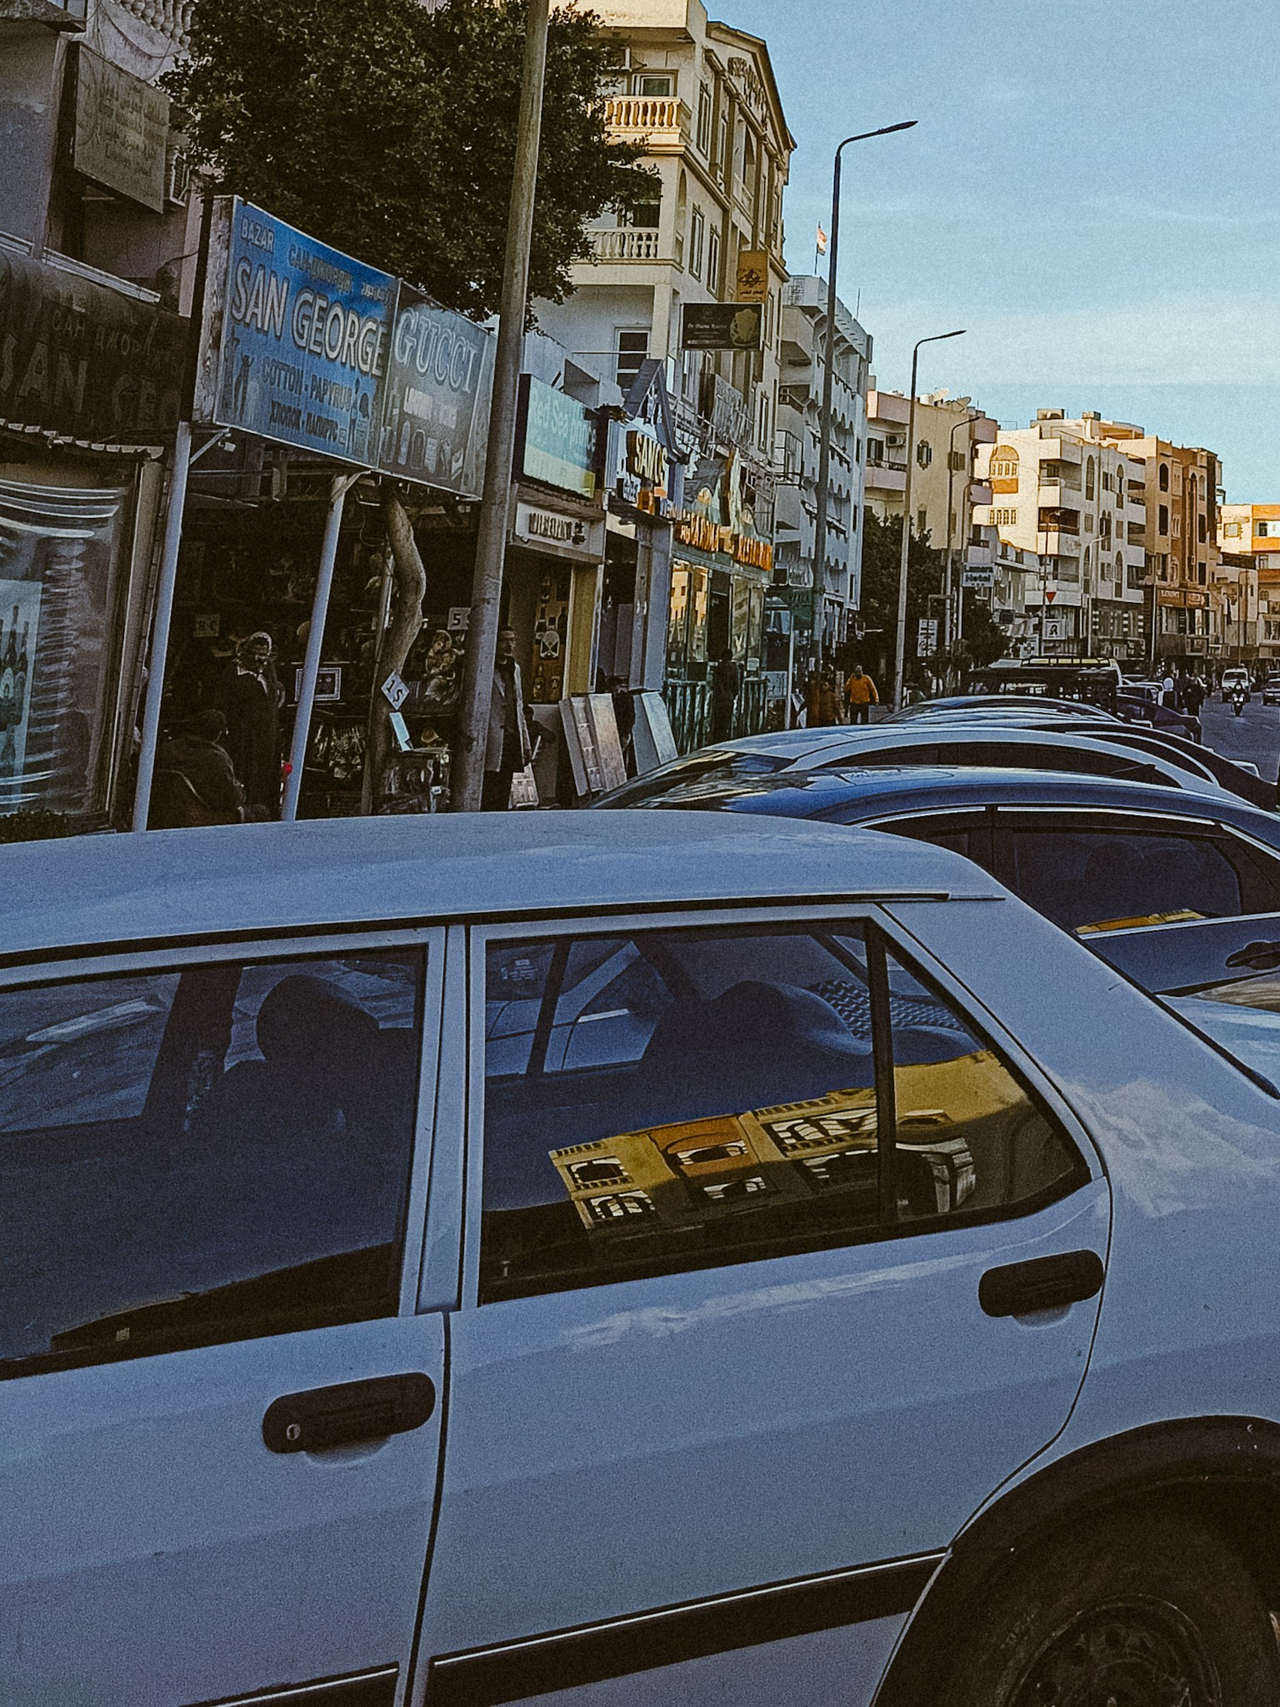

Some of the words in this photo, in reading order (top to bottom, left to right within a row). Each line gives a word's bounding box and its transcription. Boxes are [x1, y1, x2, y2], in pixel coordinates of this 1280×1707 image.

[239, 215, 276, 255] BAZAR
[231, 256, 290, 341] SAN
[291, 286, 389, 378] GEORGE
[394, 307, 480, 395] GUCCI
[262, 356, 304, 394] COTTON
[310, 374, 353, 413] PAPYRUS
[965, 574, 991, 582] Hotel
